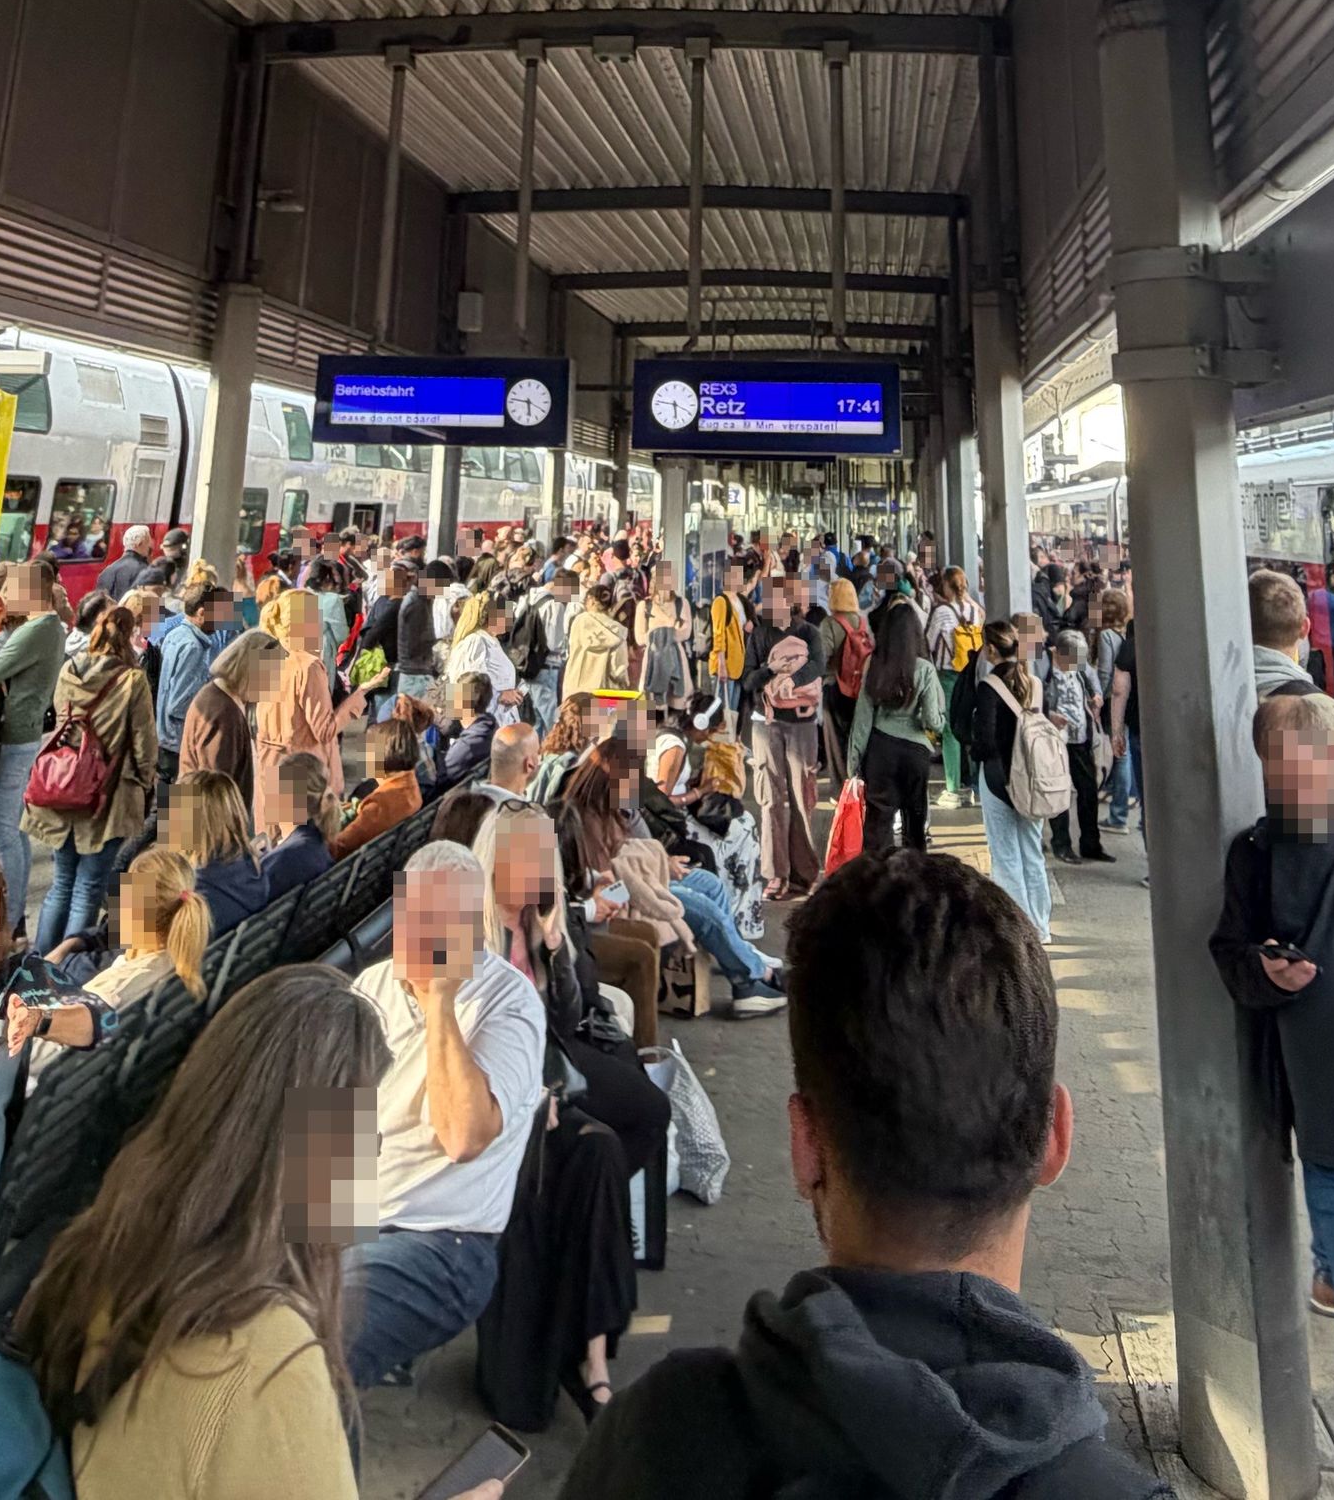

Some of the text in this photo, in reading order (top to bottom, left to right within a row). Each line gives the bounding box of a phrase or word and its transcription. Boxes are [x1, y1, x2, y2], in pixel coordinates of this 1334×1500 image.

[334, 384, 415, 397] Betriebsfahrt
[699, 383, 738, 396] REX3
[699, 396, 880, 415] Retz 17:41
